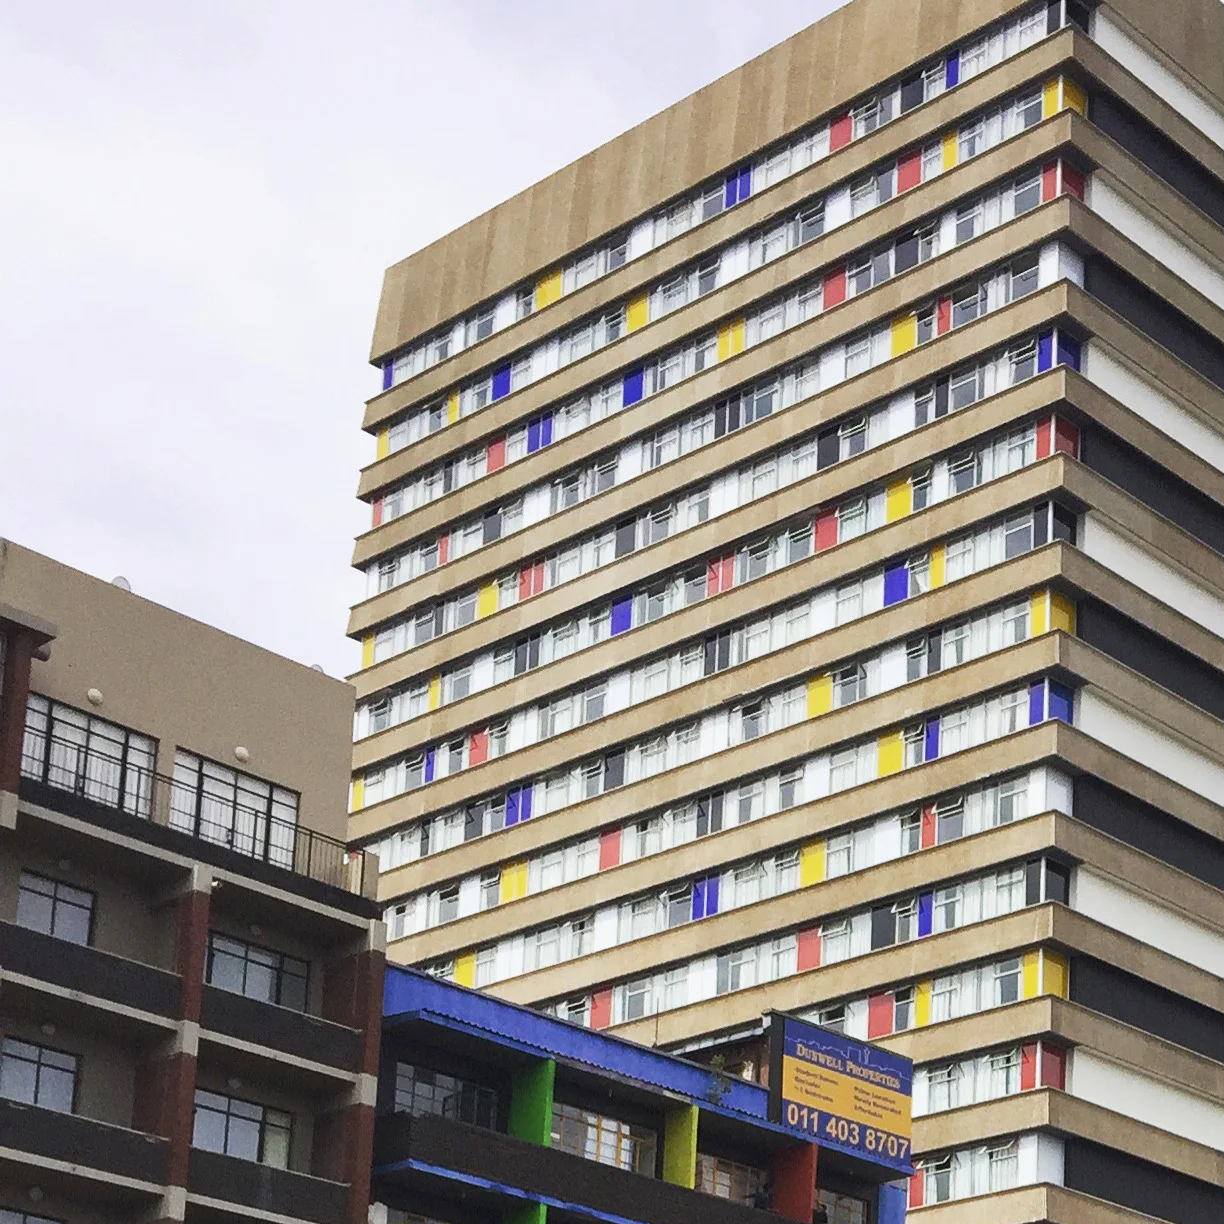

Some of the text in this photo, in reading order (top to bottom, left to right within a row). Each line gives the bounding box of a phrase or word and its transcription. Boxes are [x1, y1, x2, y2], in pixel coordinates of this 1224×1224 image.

[787, 1104, 909, 1159] 011 403 8707
